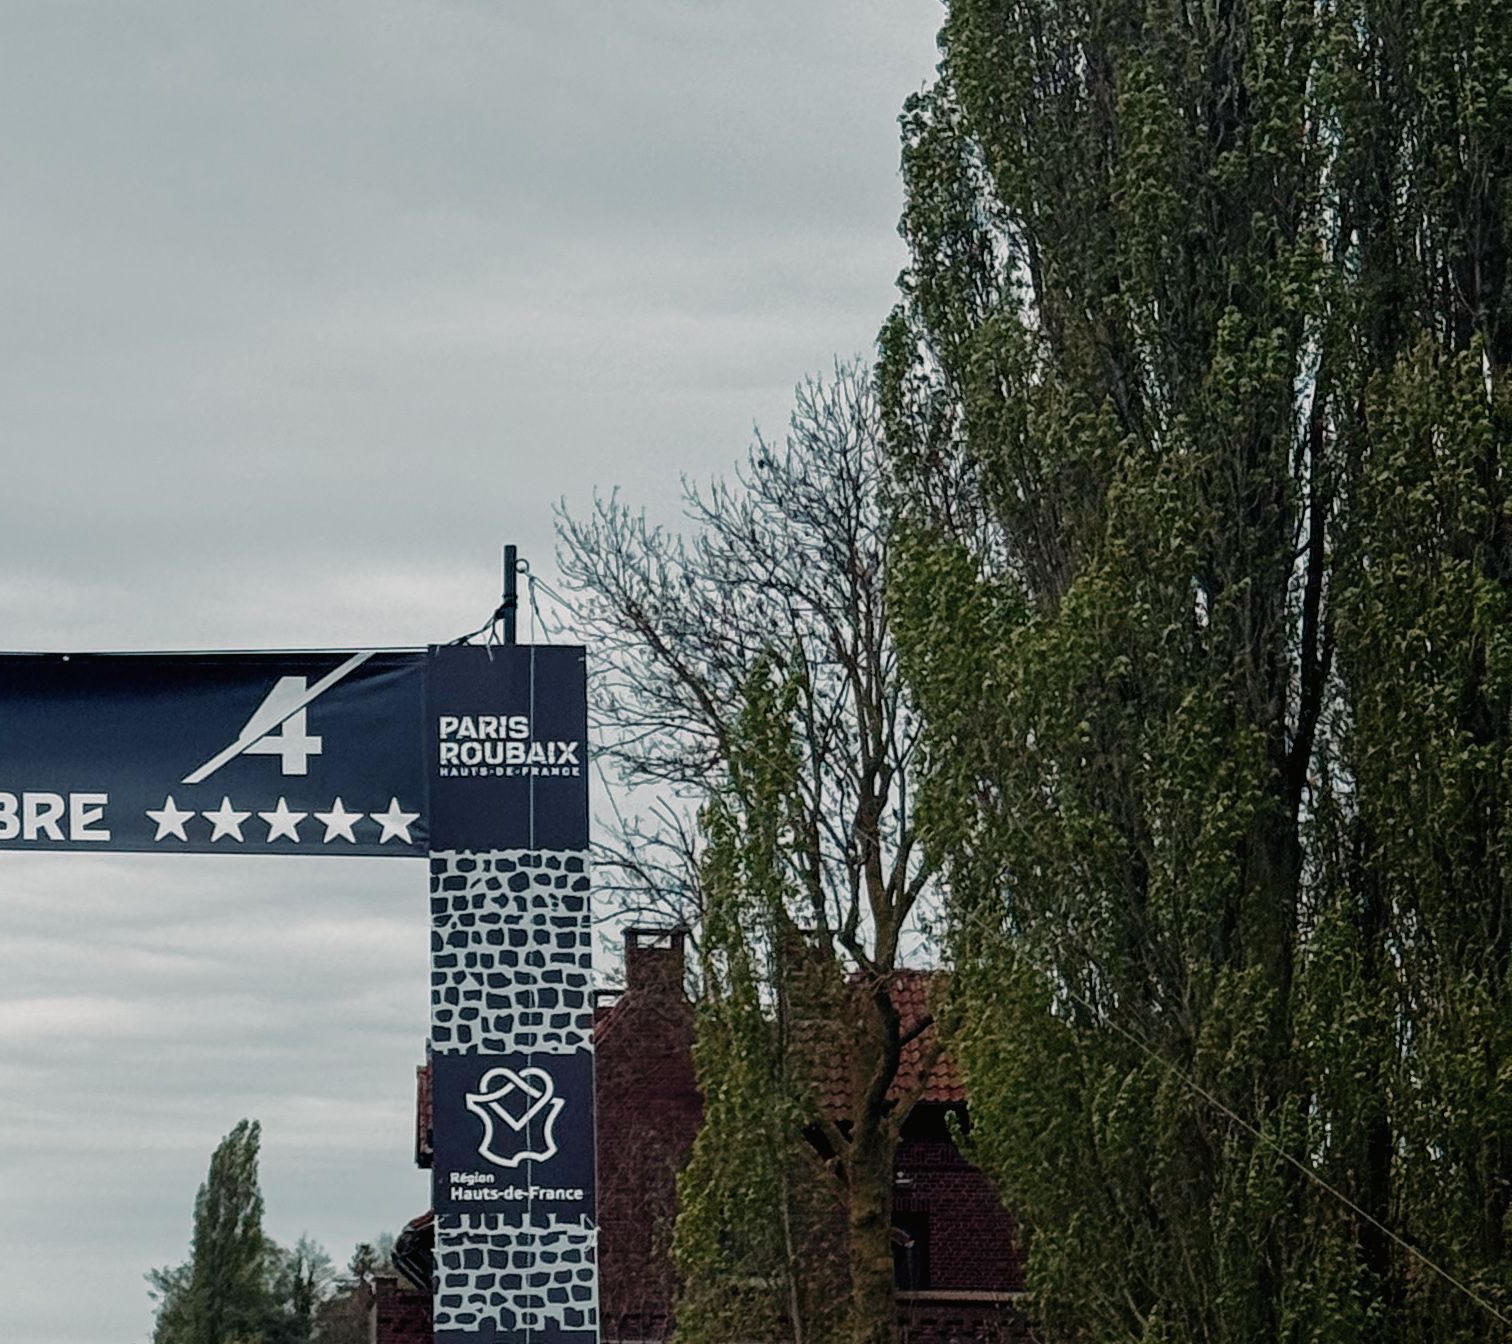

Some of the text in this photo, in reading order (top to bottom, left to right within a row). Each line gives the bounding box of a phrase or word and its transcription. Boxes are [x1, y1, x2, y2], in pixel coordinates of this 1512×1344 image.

[439, 716, 529, 739] PARIS
[439, 741, 580, 765] ROUBAIX
[449, 1171, 495, 1186] Région
[450, 1185, 584, 1201] Hauts-de-France
